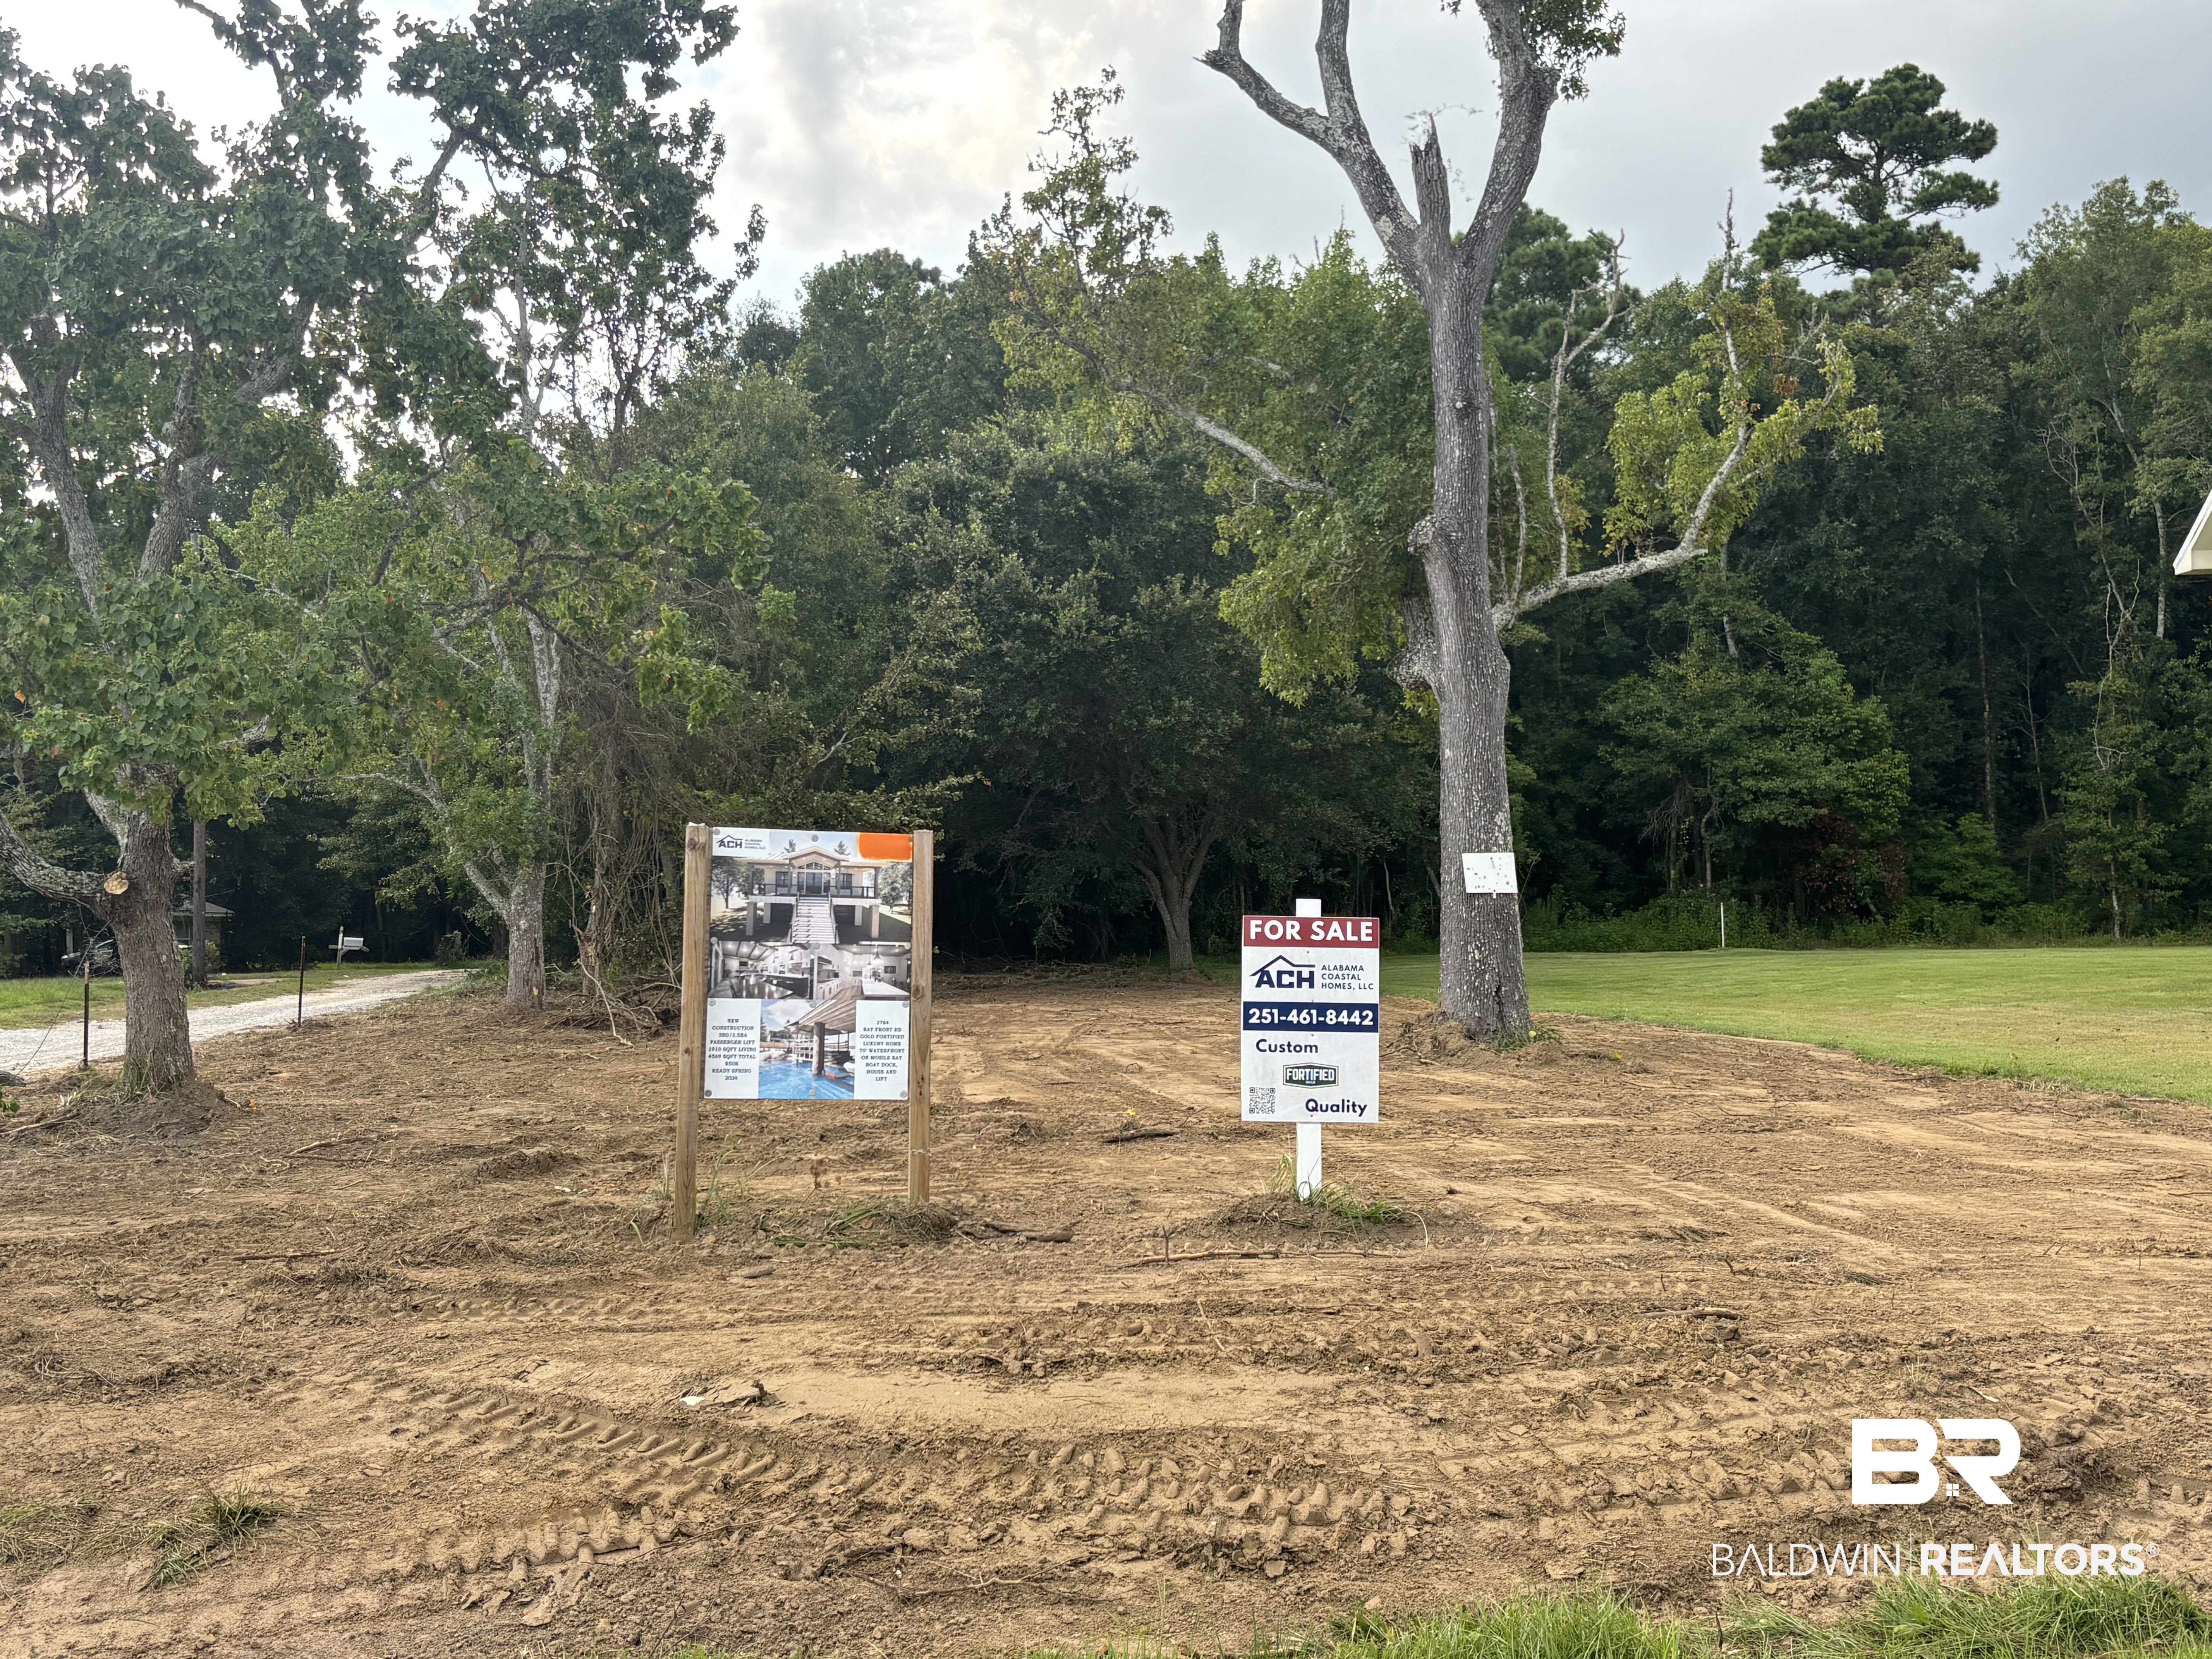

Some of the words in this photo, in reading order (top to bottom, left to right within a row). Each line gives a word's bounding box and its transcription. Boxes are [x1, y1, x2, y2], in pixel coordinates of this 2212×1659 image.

[1250, 920, 1302, 940] FOR
[1310, 921, 1372, 941] SALE
[1255, 970, 1315, 989] ACH
[1249, 1008, 1374, 1025] 251-461-8442
[1256, 1039, 1318, 1053] Custom
[1286, 1068, 1334, 1081] FORTIFIED
[1305, 1098, 1367, 1117] Quality
